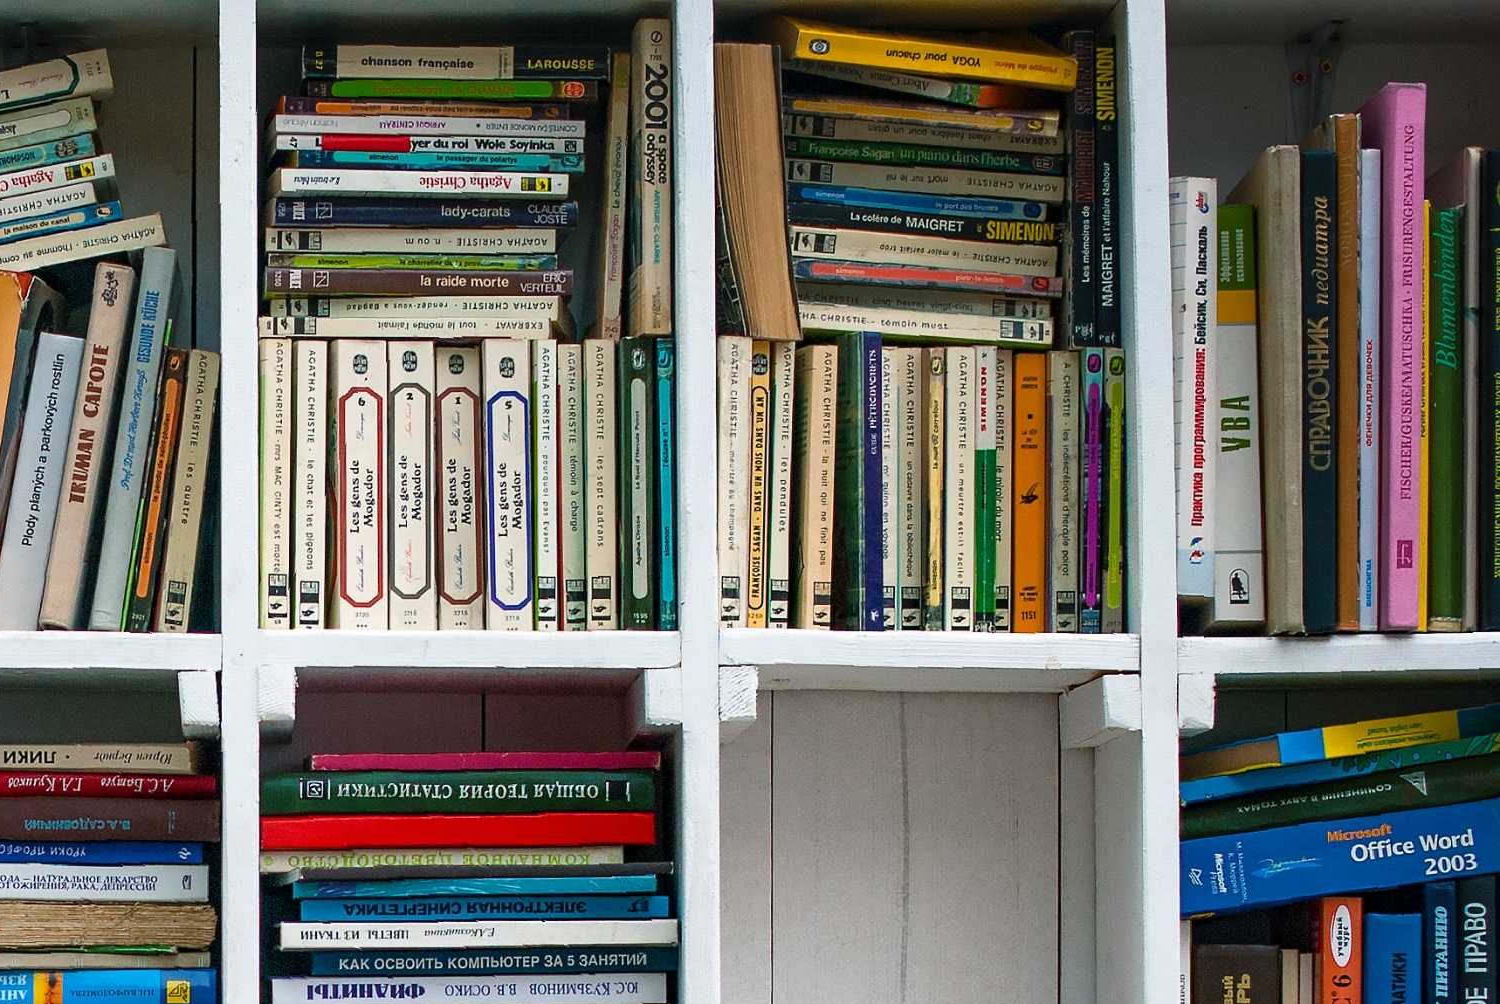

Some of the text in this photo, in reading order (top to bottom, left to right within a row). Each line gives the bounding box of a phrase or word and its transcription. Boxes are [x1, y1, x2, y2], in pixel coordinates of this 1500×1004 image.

[361, 56, 595, 72] chanson française LAROUSSE
[885, 47, 981, 68] YOGA pour chacun
[645, 64, 668, 130] 2001
[1096, 47, 1115, 123] SIMENON
[645, 133, 656, 186] odyssey
[658, 144, 669, 184] space
[440, 206, 511, 219] lady-carats
[906, 217, 1055, 241] MAIGRET SIMENON
[1402, 124, 1414, 288] FRISURENGESTALTUNG
[1196, 225, 1208, 272] Паскаль
[1433, 208, 1461, 370] Blumenbinden
[1308, 195, 1332, 473] СПРАВОЧНИК педиатра
[22, 513, 40, 547] Plody
[53, 353, 65, 388] rostlin
[69, 343, 108, 504] TRUMAN CAPOTE
[1220, 394, 1251, 454] VBA
[350, 460, 361, 533] Les gens de
[363, 469, 374, 528] Mogador
[1190, 463, 1203, 527] Практика
[3, 751, 57, 765] ЛИКИ
[337, 783, 599, 798] ОБЩАЯ ТЕОРИЯ СТАТИСТИКИ
[1326, 824, 1392, 842] Microsoft
[1351, 829, 1474, 862] Office Word
[1424, 854, 1478, 876] 2003
[339, 959, 370, 970] КАК
[374, 957, 444, 970] ОСВОИТЬ
[448, 956, 540, 969] КОМПЬЮТЕР
[544, 955, 564, 967] ЗА
[579, 952, 647, 966] ЗАНЯТИЙ
[1464, 901, 1488, 975] ПРАВО
